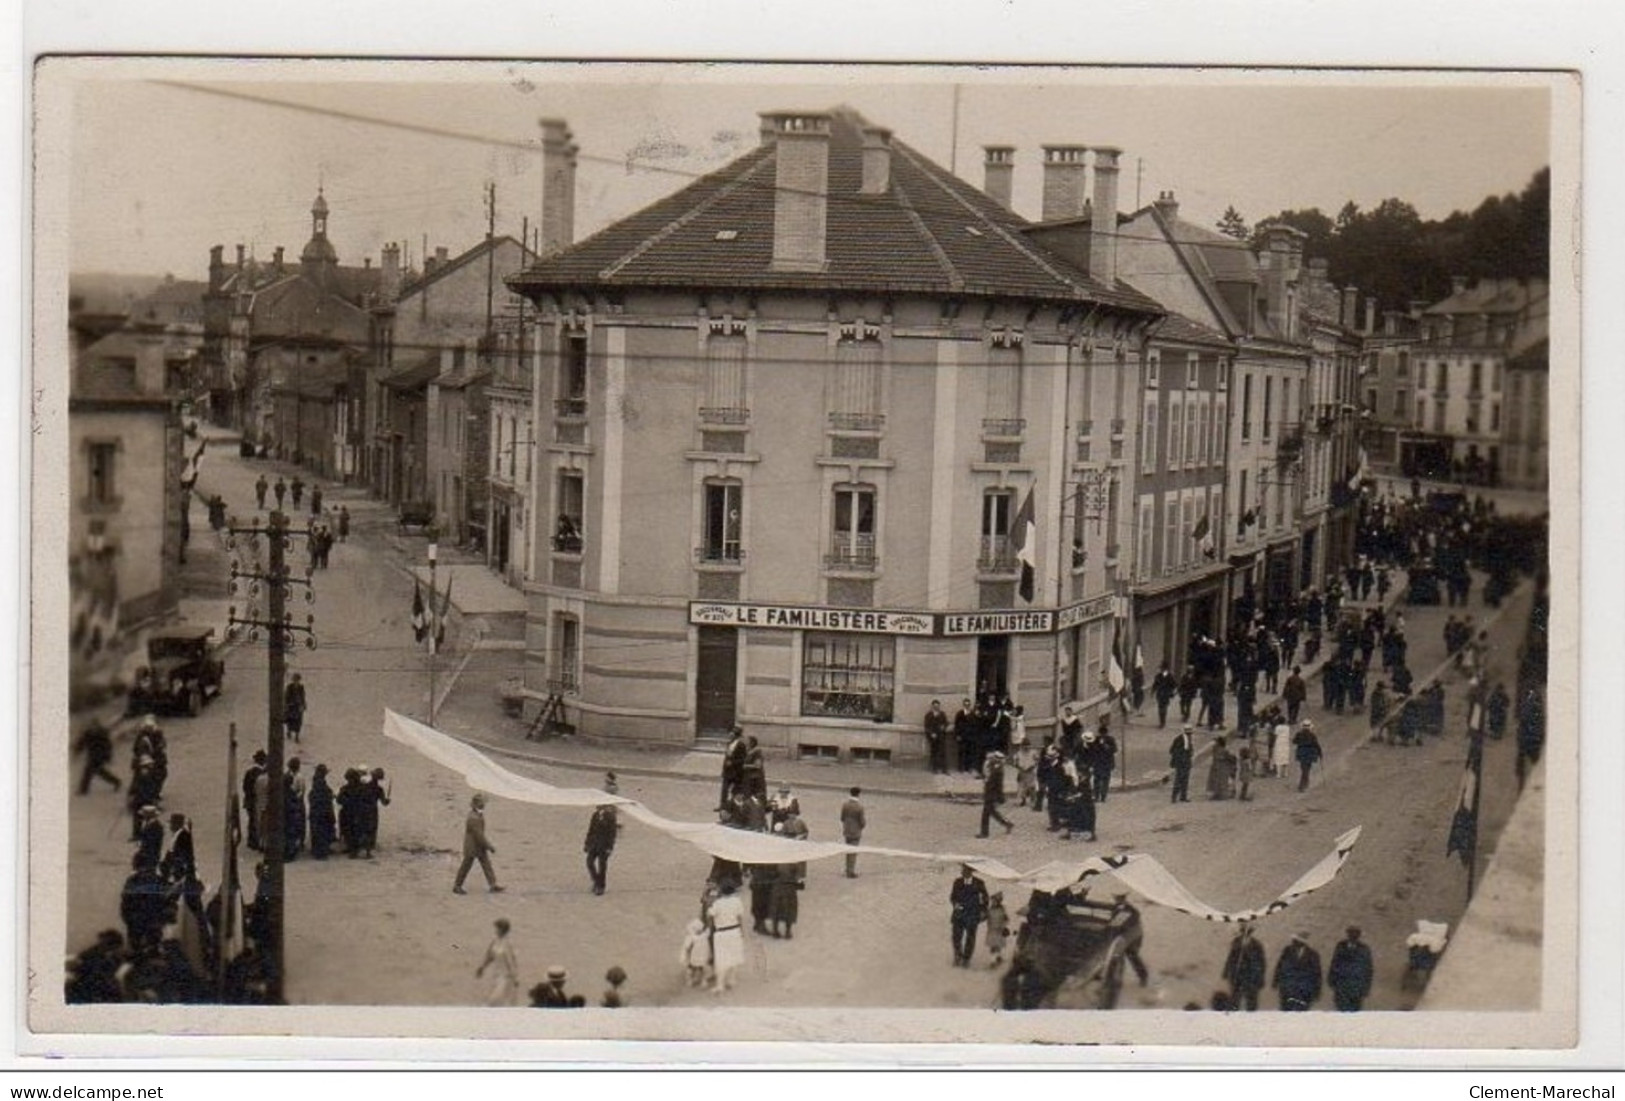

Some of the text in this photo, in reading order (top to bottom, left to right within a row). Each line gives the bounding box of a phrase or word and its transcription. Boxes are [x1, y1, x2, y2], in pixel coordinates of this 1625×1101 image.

[737, 608, 758, 623] LE
[767, 608, 888, 631] FAMILISTÈRE
[949, 611, 1048, 632] LE FAMILISTÈRE
